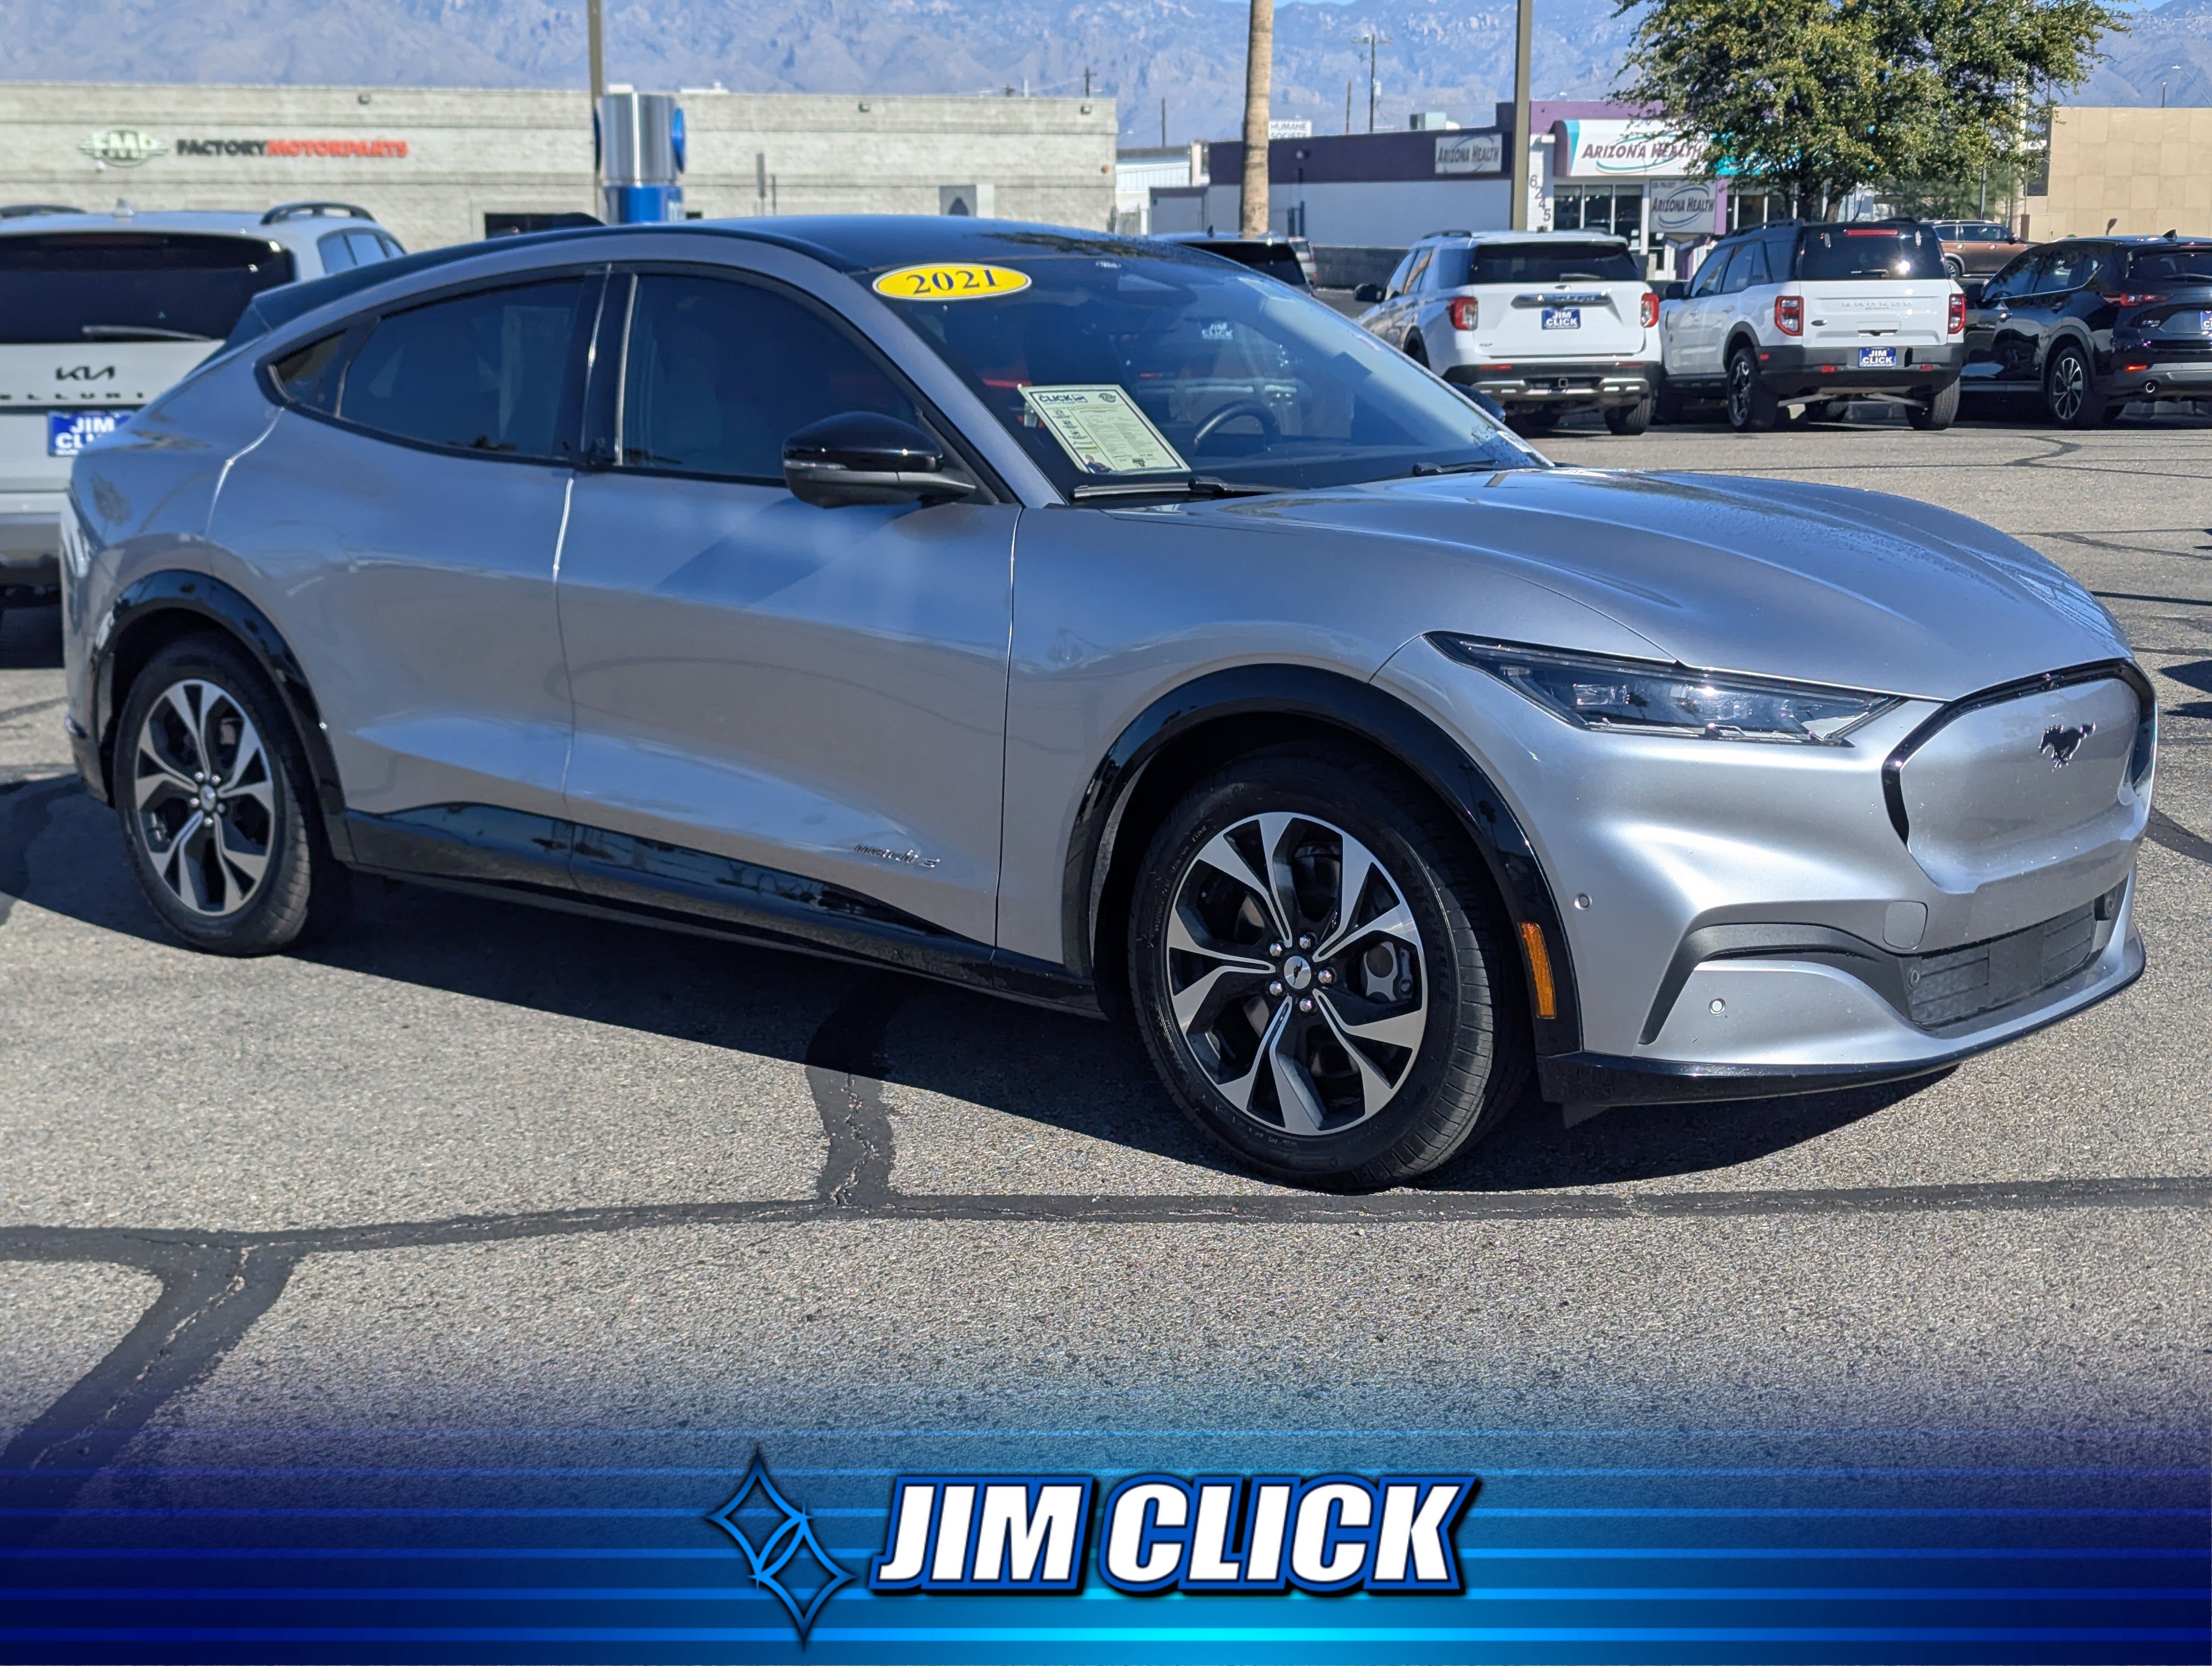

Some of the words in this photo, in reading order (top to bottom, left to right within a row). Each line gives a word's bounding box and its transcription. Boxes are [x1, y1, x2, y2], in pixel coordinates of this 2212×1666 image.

[1581, 143, 1645, 159] ARIZONA
[906, 269, 1001, 294] 2021
[1546, 317, 1577, 326] CLICK
[1552, 311, 1572, 319] JIM
[69, 416, 115, 434] JIM
